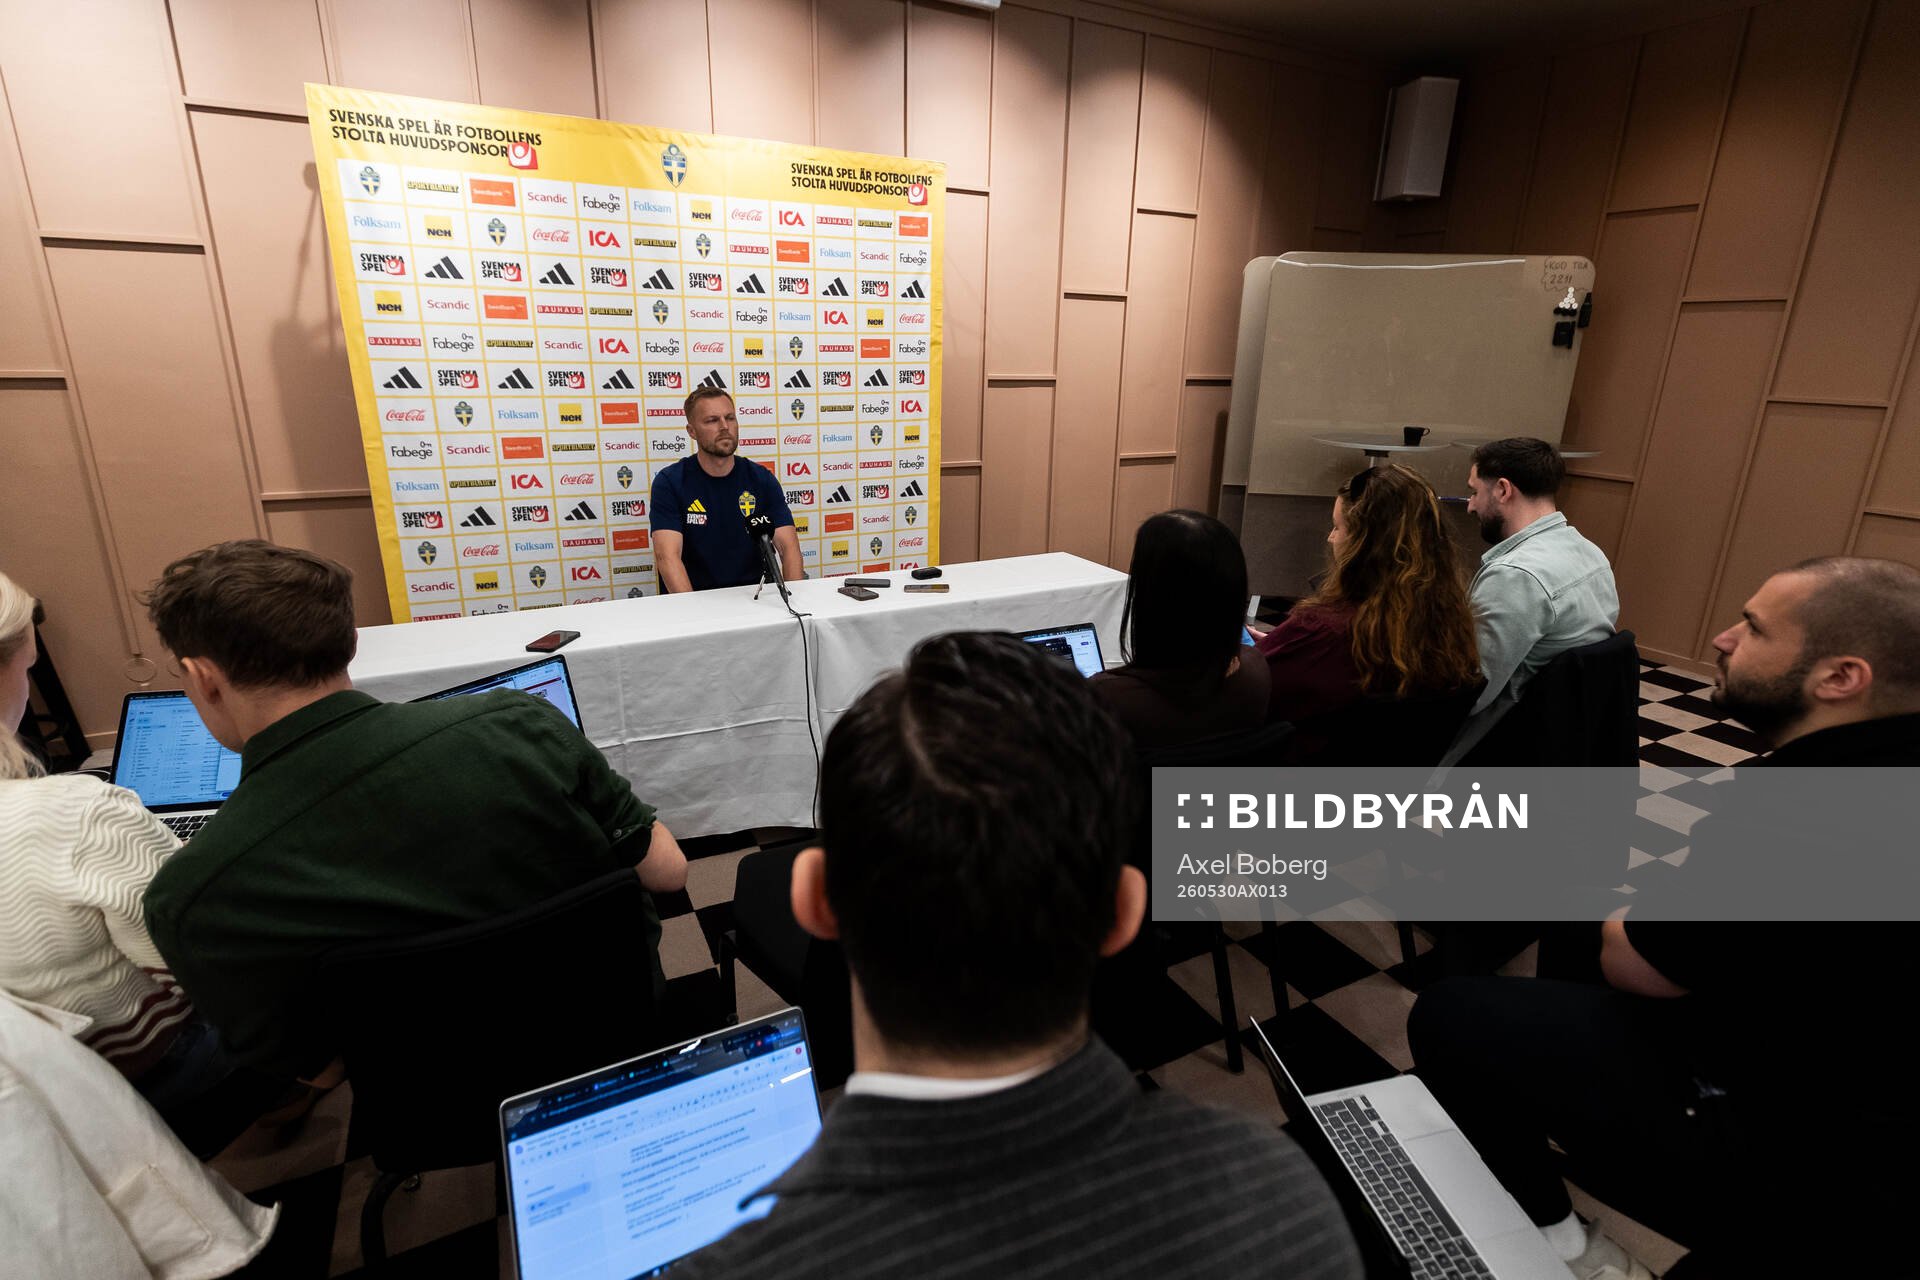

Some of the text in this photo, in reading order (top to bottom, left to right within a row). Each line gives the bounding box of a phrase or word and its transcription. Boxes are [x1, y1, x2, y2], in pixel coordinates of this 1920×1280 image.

[329, 109, 542, 146] SVENSKA SPEL ÄR FOTBOLLENS
[331, 126, 508, 158] STOLTA HUVUDSPONSOR
[791, 163, 932, 186] SVENSKA SPEL ÄR FOTBOLLENS
[791, 176, 909, 196] STOLTA HUVUDSPONSOR
[527, 192, 568, 204] Scandic
[583, 197, 620, 212] Fabege
[633, 200, 671, 213] Folksam
[353, 216, 400, 228] Folksam
[779, 210, 805, 227] ICA
[816, 216, 852, 226] BAUHAUS
[427, 228, 452, 237] NCH
[588, 230, 621, 248] ICA
[730, 244, 769, 254] BAUHAUS
[820, 248, 852, 258] Folksam
[860, 252, 889, 261] Scandic
[900, 253, 926, 265] Fabege
[362, 261, 385, 272] SPEL
[482, 268, 503, 278] SPEL
[591, 274, 610, 284] SPEL
[689, 280, 706, 289] SPEL
[779, 284, 794, 292] SPEL
[862, 286, 876, 294] SPEL
[377, 304, 402, 312] NCH
[427, 299, 470, 310] Scandic
[537, 306, 583, 314] BAUHAUS
[690, 310, 724, 319] Scandic
[736, 311, 767, 324] Fabege
[779, 312, 811, 321] Folksam
[824, 310, 848, 325] ICA
[368, 336, 422, 346] BAUHAUS
[433, 338, 474, 352] Fabege
[544, 340, 584, 350] Scandic
[599, 338, 630, 354] ICA
[646, 342, 680, 355] Fabege
[899, 344, 926, 355] Fabege
[439, 378, 460, 386] SPEL
[549, 378, 568, 386] SPEL
[740, 379, 756, 387] SPEL
[738, 406, 772, 415] Scandic
[862, 404, 889, 415] Fabege
[901, 400, 922, 413] ICA
[498, 410, 539, 419] Folksam
[822, 434, 852, 443] Folksam
[446, 444, 490, 455] Scandic
[605, 441, 640, 450] Scandic
[652, 440, 686, 452] Fabege
[392, 446, 432, 460] Fabege
[787, 462, 811, 476] ICA
[822, 462, 853, 472] Scandic
[859, 460, 892, 468] BAUHAUS
[899, 459, 924, 470] Fabege
[396, 482, 440, 492] Folksam
[511, 474, 544, 490] ICA
[612, 508, 630, 516] SPEL
[512, 513, 532, 522] SPEL
[750, 515, 771, 526] svt
[862, 515, 890, 524] Scandic
[403, 519, 424, 528] SPEL
[514, 542, 554, 552] Folksam
[562, 538, 605, 547] BAUHAUS
[571, 566, 602, 581] ICA
[411, 582, 455, 593] Scandic
[476, 582, 498, 590] NCH
